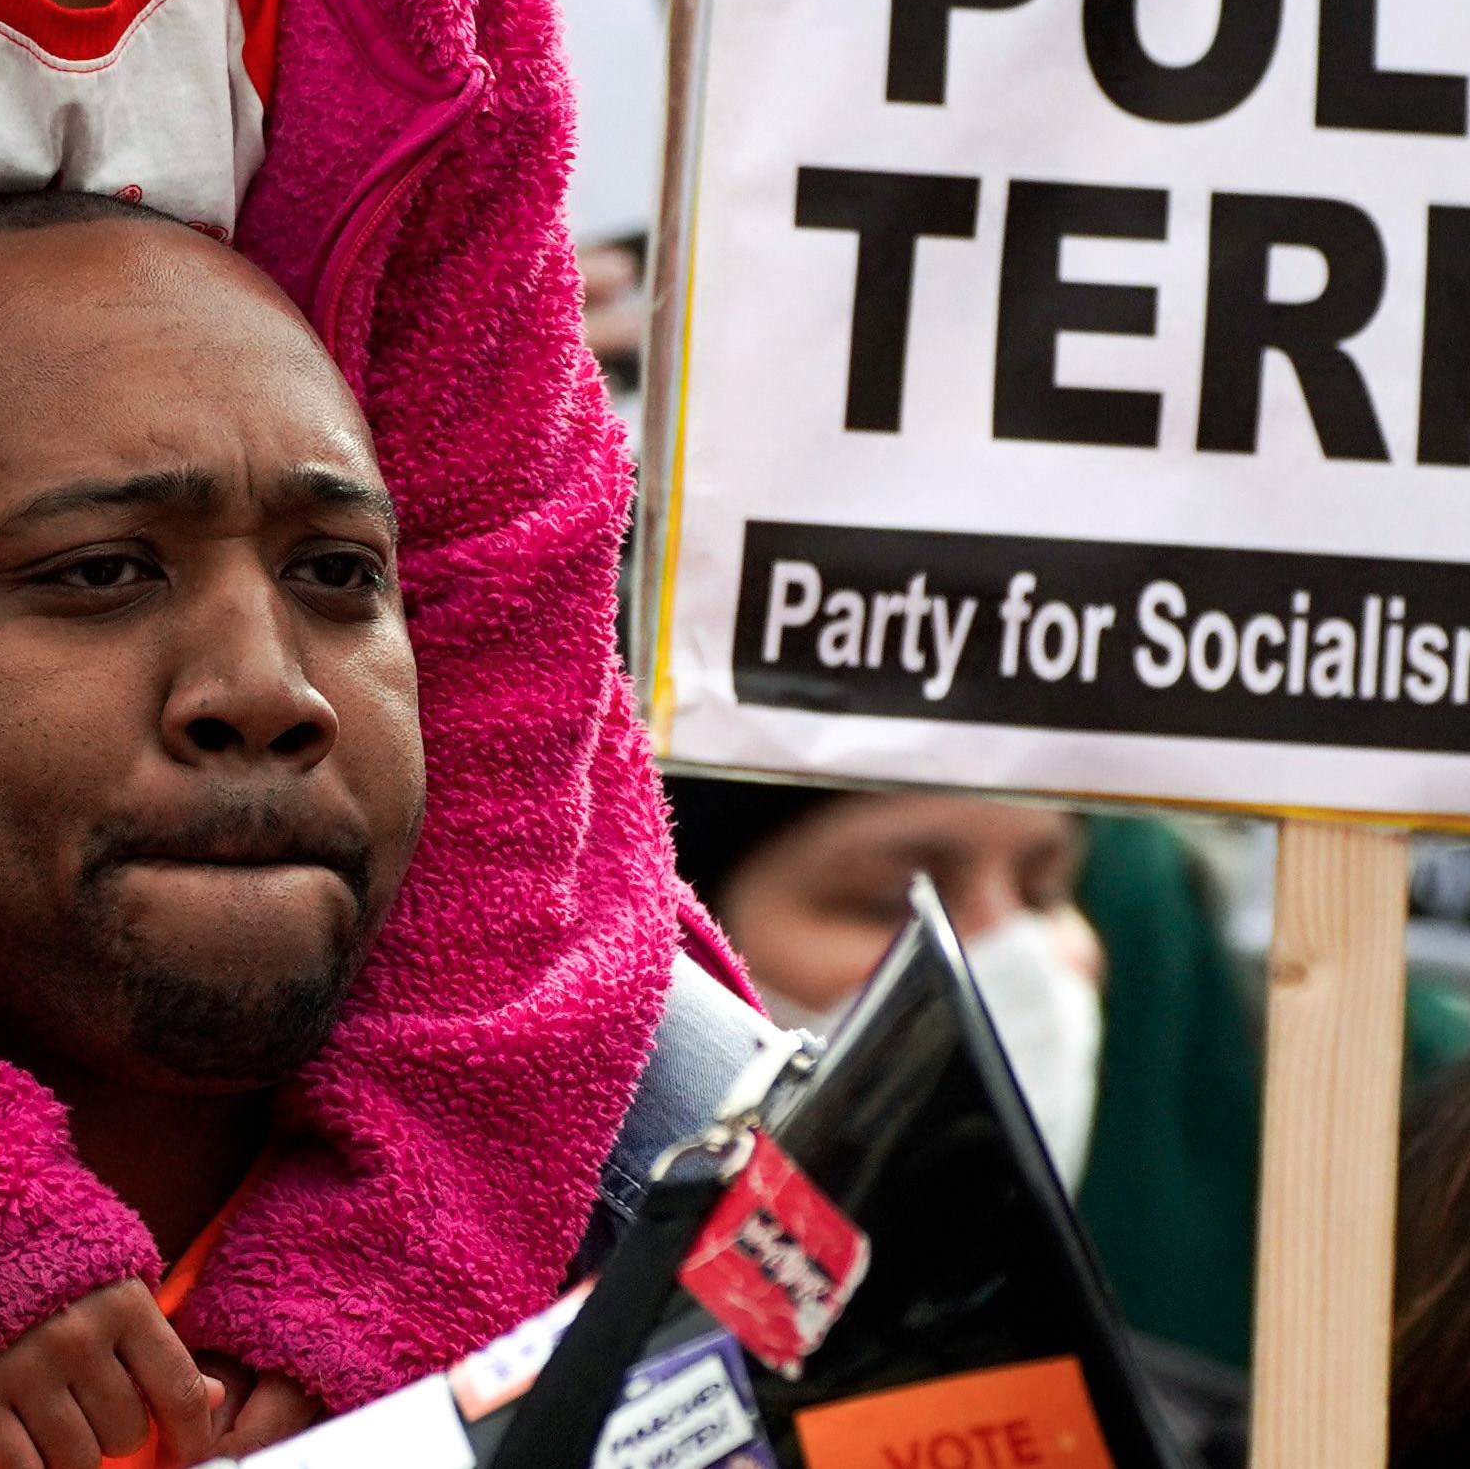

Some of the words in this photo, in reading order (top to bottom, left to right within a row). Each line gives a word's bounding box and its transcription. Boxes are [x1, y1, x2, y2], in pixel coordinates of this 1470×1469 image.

[762, 561, 977, 700] Party
[999, 571, 1115, 680] for
[881, 1416, 1044, 1469] VOTE
